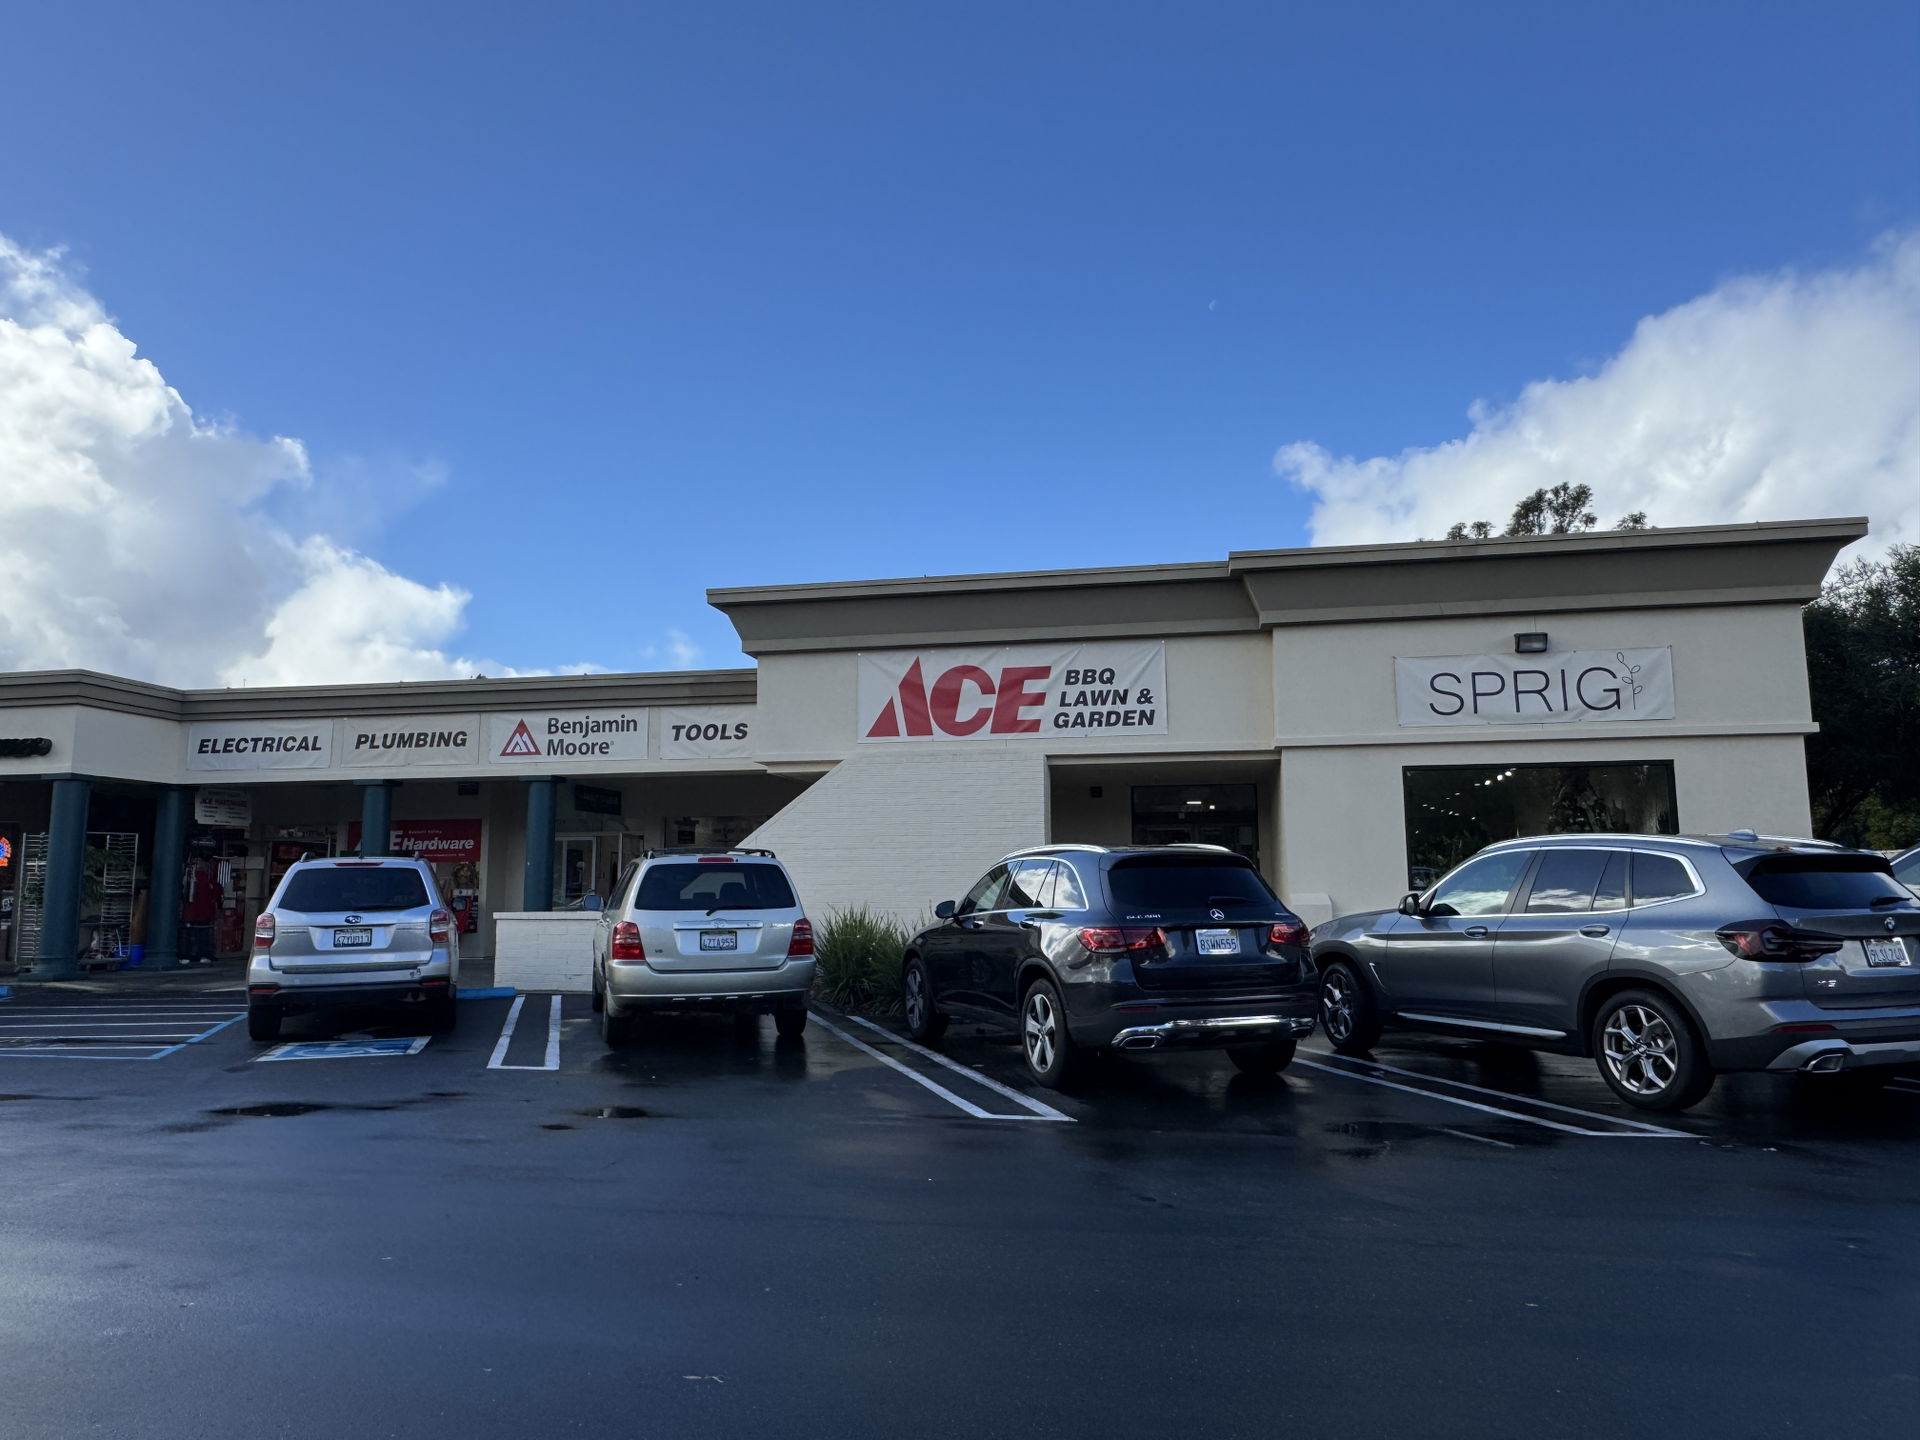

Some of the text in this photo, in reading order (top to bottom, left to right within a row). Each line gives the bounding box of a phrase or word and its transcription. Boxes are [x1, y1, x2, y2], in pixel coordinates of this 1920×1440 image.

[1064, 667, 1116, 686] BBQ
[866, 655, 1052, 738] ACE
[1059, 688, 1154, 708] LAWN &
[1429, 666, 1621, 716] SPRIG
[547, 714, 638, 738] Benjamin
[1053, 709, 1156, 729] GARDEN
[354, 731, 468, 750] PLUMBING
[671, 723, 748, 742] TOOLS
[197, 735, 322, 755] ELECTRICAL
[402, 837, 475, 851] Hardware
[1200, 938, 1237, 950] 8SWN555
